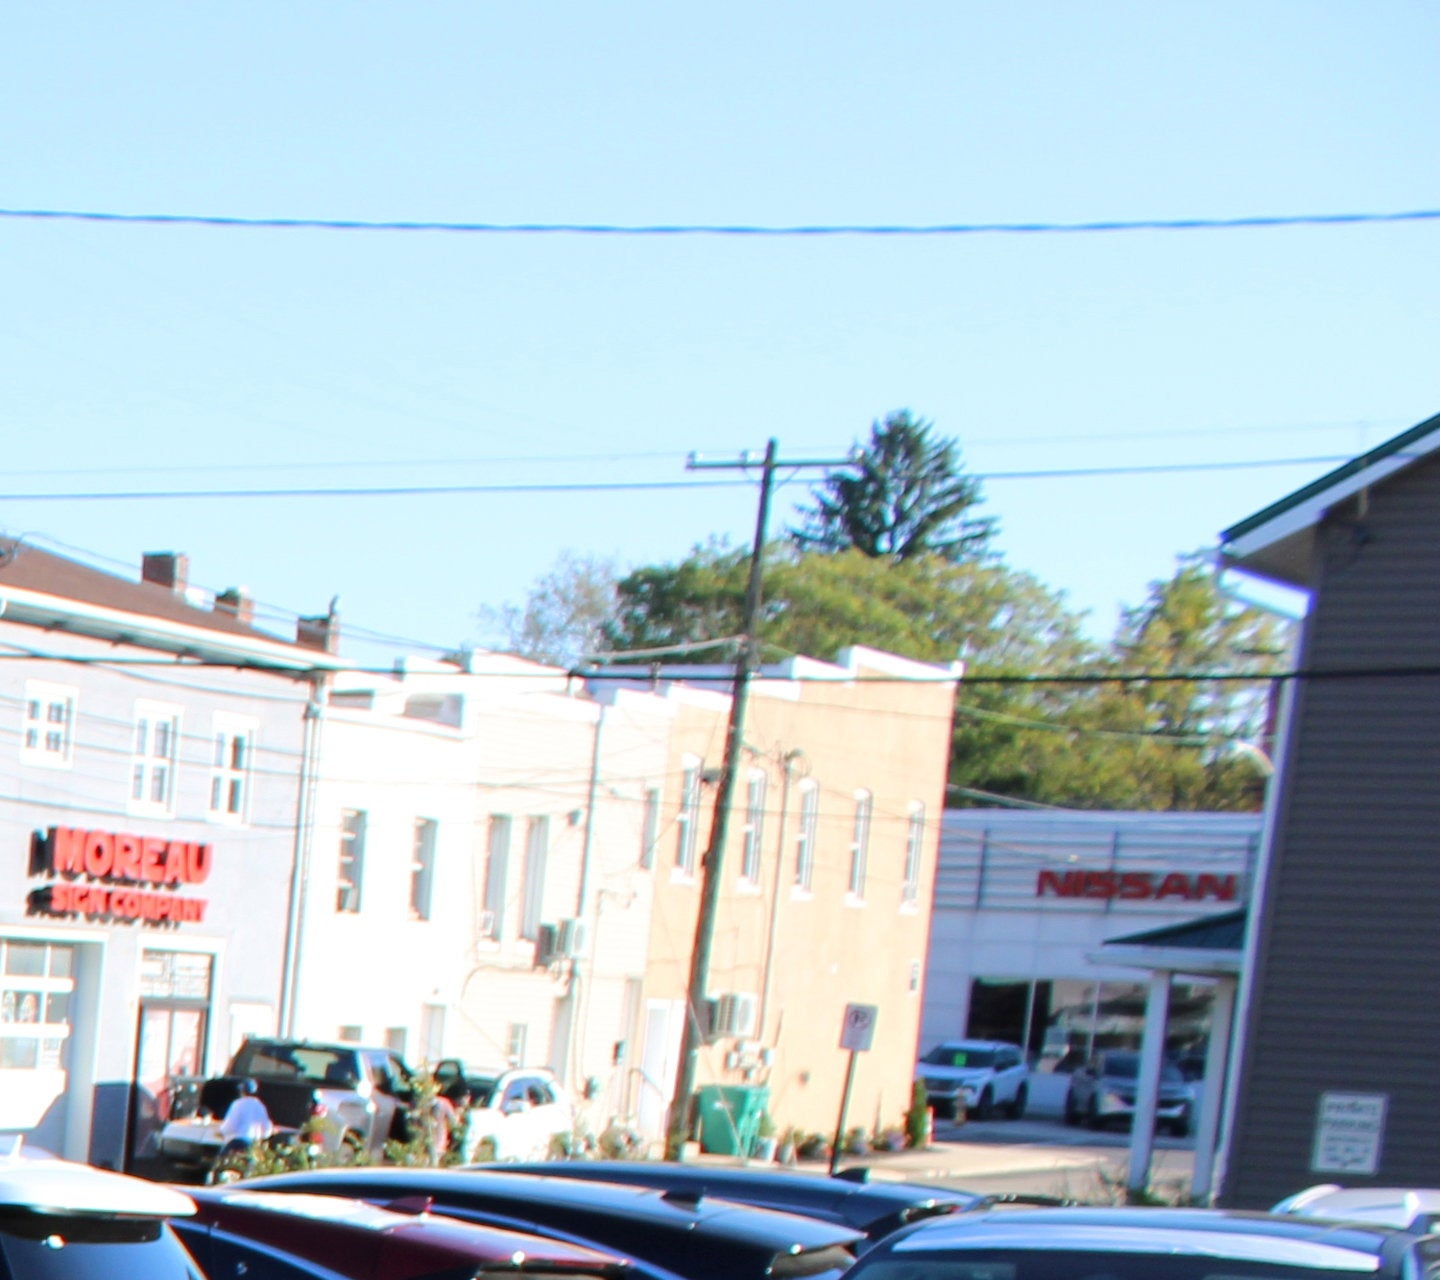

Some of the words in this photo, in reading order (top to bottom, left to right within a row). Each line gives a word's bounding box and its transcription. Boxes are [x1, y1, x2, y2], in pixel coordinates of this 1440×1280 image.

[53, 825, 214, 885] MOREAU
[51, 884, 109, 915] SIGN
[110, 890, 209, 923] COMPANY
[1036, 869, 1237, 901] NISSAN
